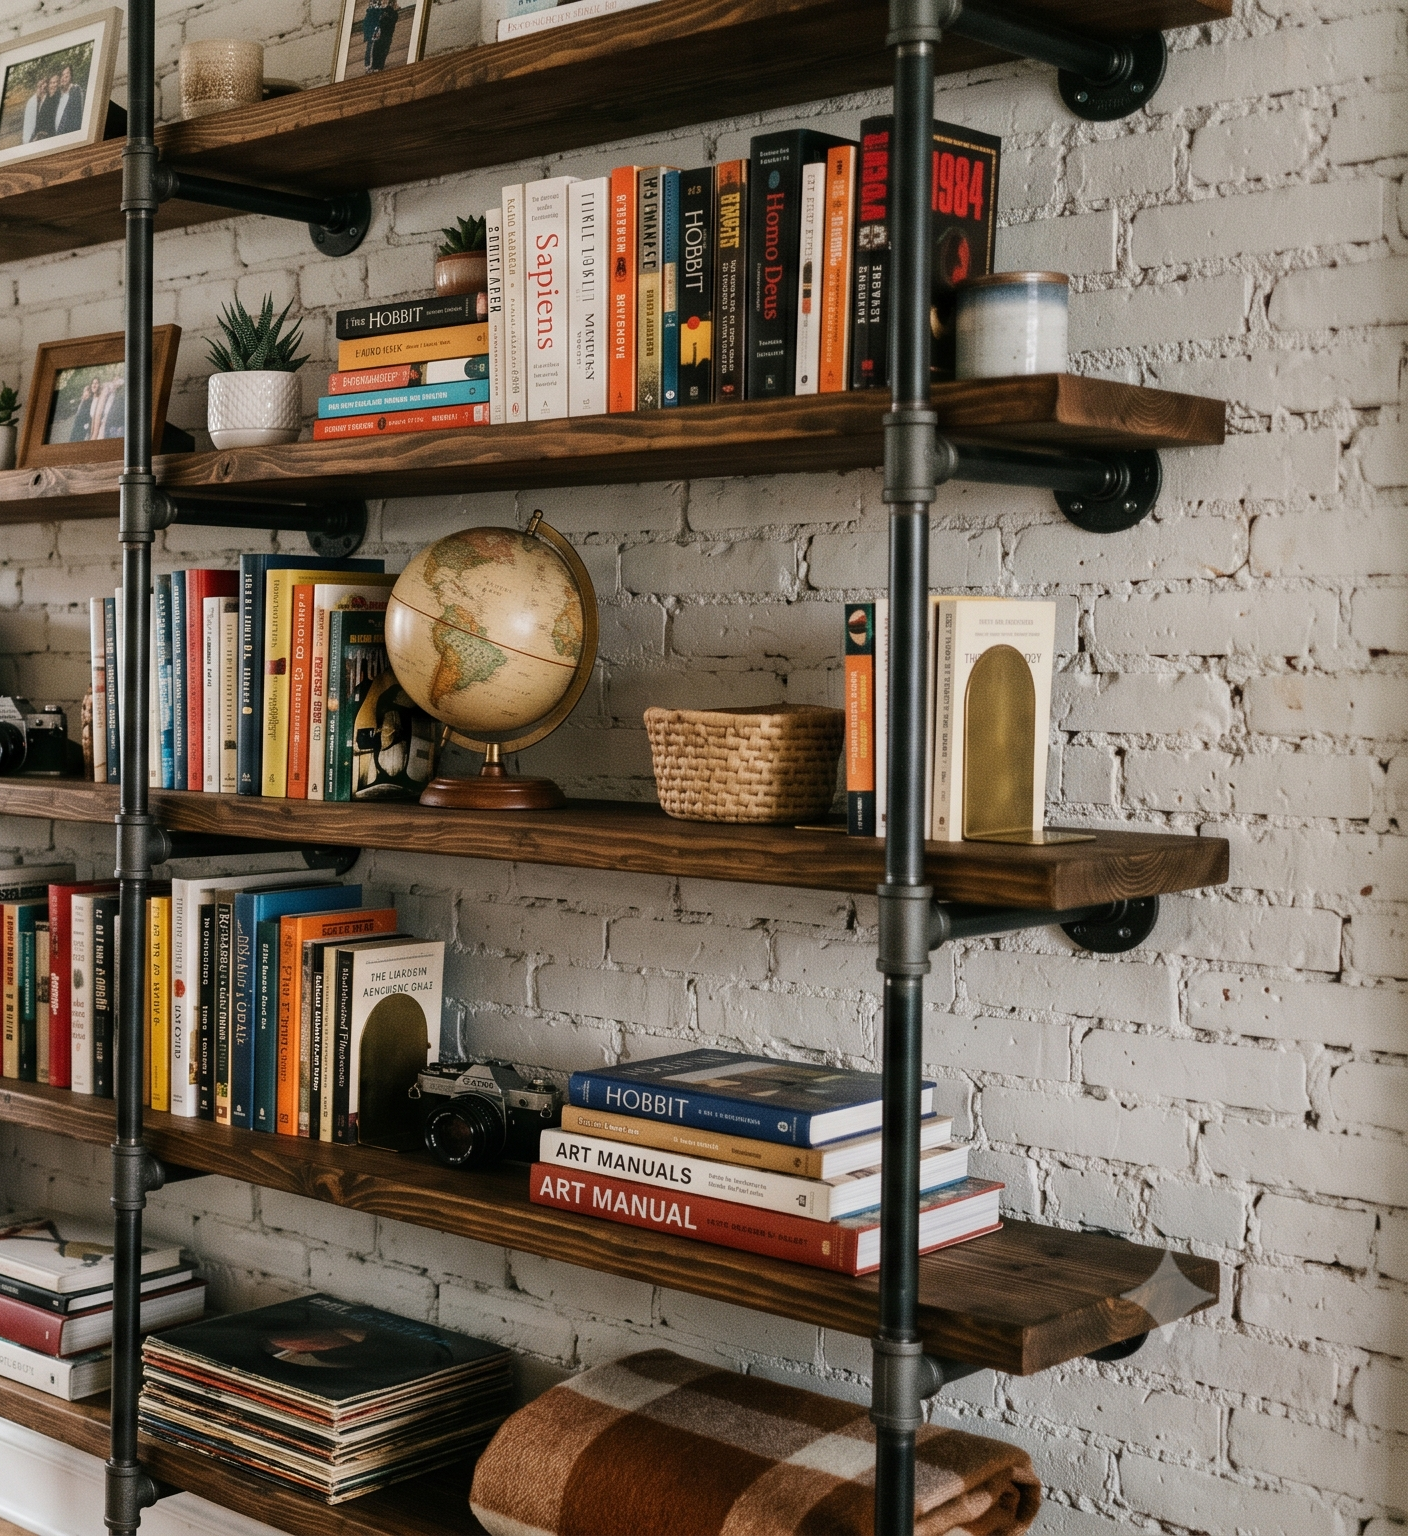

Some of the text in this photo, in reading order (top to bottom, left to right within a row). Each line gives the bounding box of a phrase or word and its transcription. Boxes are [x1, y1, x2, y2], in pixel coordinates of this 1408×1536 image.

[931, 150, 984, 221] 1984
[684, 209, 704, 293] HOBBIT
[763, 192, 785, 320] Homo Deus
[369, 306, 424, 329] HOBBIT
[527, 233, 559, 350] Sapiens
[606, 1085, 689, 1119] HOBBIT
[556, 1142, 692, 1185] ART MANUALS
[539, 1175, 698, 1230] ART MANUAL
